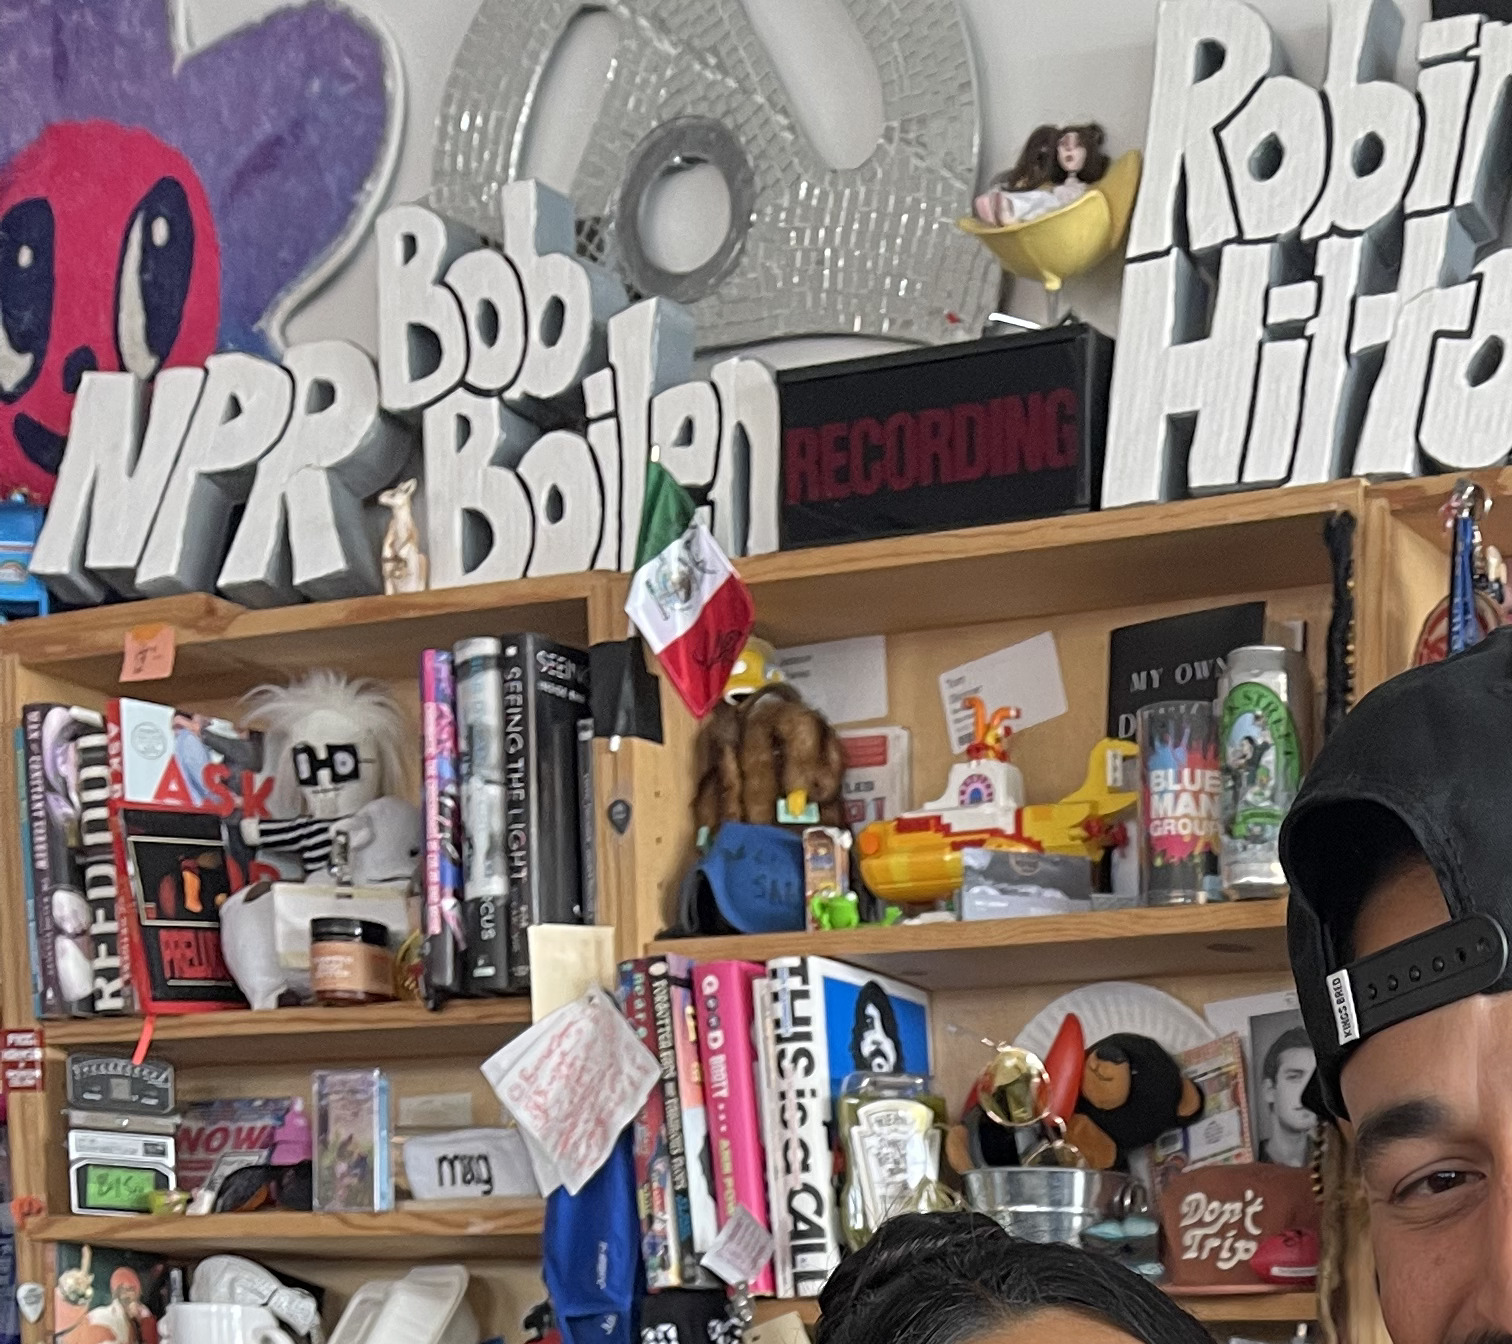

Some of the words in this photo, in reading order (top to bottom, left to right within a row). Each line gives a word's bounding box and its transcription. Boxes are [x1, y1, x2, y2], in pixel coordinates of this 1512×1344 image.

[376, 180, 593, 410] Bob
[422, 297, 780, 590] Boilen
[786, 388, 1078, 503] RECORDING
[30, 340, 383, 595] NPR
[1130, 667, 1164, 693] MY
[152, 754, 277, 819] ASK
[1150, 768, 1222, 792] BLUE
[1149, 816, 1225, 837] GROUP
[1150, 793, 1221, 818] MAN
[1332, 977, 1345, 1005] BRED
[1338, 1005, 1352, 1039] KINGS
[1180, 1189, 1265, 1236] Don't
[786, 1180, 828, 1290] CALL
[1180, 1230, 1259, 1270] Trip
